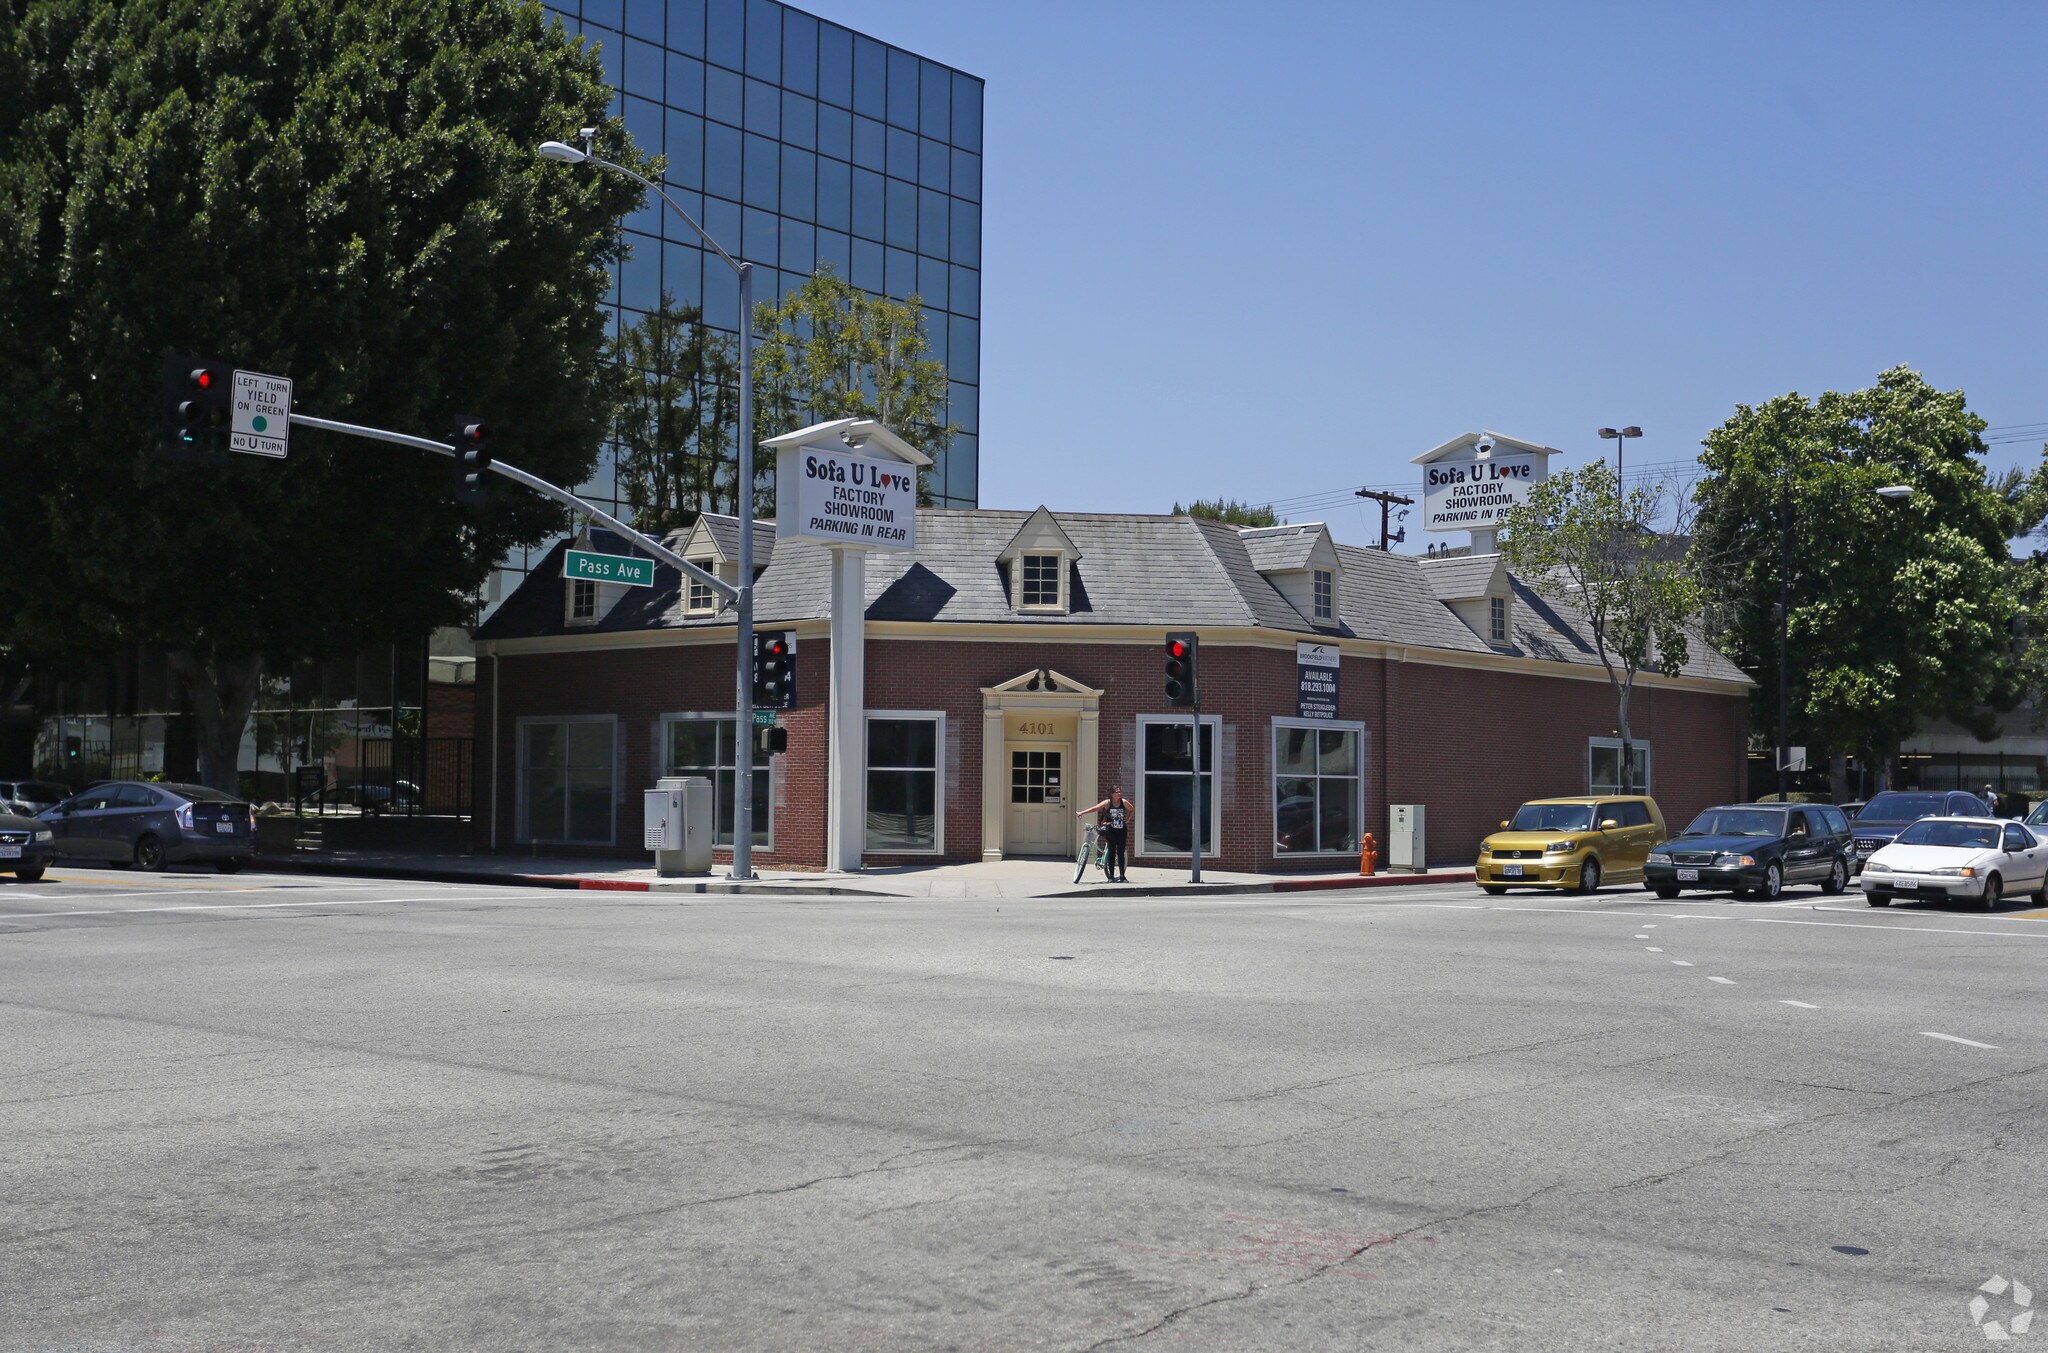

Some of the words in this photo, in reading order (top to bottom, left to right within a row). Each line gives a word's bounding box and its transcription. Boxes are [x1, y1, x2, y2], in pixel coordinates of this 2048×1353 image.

[237, 377, 259, 388] LEFT
[266, 381, 288, 393] TURN
[247, 389, 277, 404] YIELD
[237, 401, 250, 411] ON
[255, 405, 284, 416] GREEN
[233, 437, 246, 447] NO
[248, 437, 258, 449] U
[260, 441, 283, 452] TURN
[805, 455, 846, 484] Sofa
[850, 462, 865, 486] U
[1428, 467, 1466, 486] Sofa
[1470, 464, 1484, 482] U
[833, 486, 886, 506] FACTORY
[1453, 482, 1504, 497] FACTORY
[1445, 493, 1513, 509] SHOWROOM
[824, 501, 894, 523] SHOWROOM
[1432, 510, 1478, 523] PARKING
[1481, 509, 1493, 519] IN
[809, 517, 859, 535] PARKING
[861, 523, 874, 537] IN
[876, 527, 906, 541] REAR
[579, 558, 610, 575] Pass
[617, 563, 641, 579] Ave
[1304, 671, 1333, 682] AVAILABLE
[1300, 681, 1336, 693] 818.293.1004
[1300, 702, 1314, 710] PETER
[752, 713, 768, 724] Pass
[1303, 710, 1315, 718] KELLY
[1019, 722, 1055, 735] 4101
